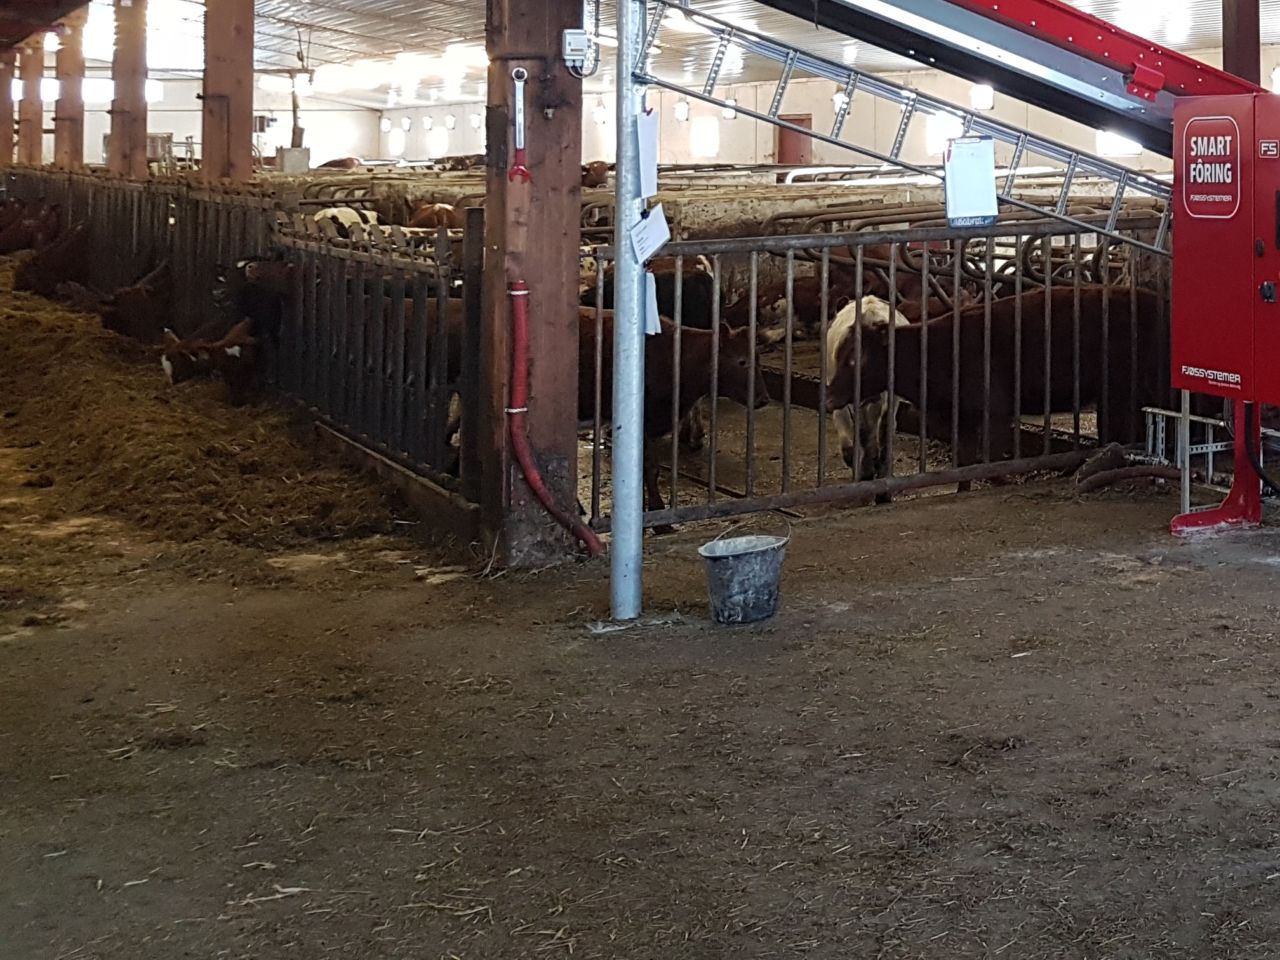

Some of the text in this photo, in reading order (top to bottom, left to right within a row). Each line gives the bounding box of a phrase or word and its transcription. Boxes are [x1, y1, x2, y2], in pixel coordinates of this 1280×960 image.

[1190, 136, 1232, 156] SMART
[1261, 143, 1277, 155] FS
[1190, 158, 1232, 183] FÔRING
